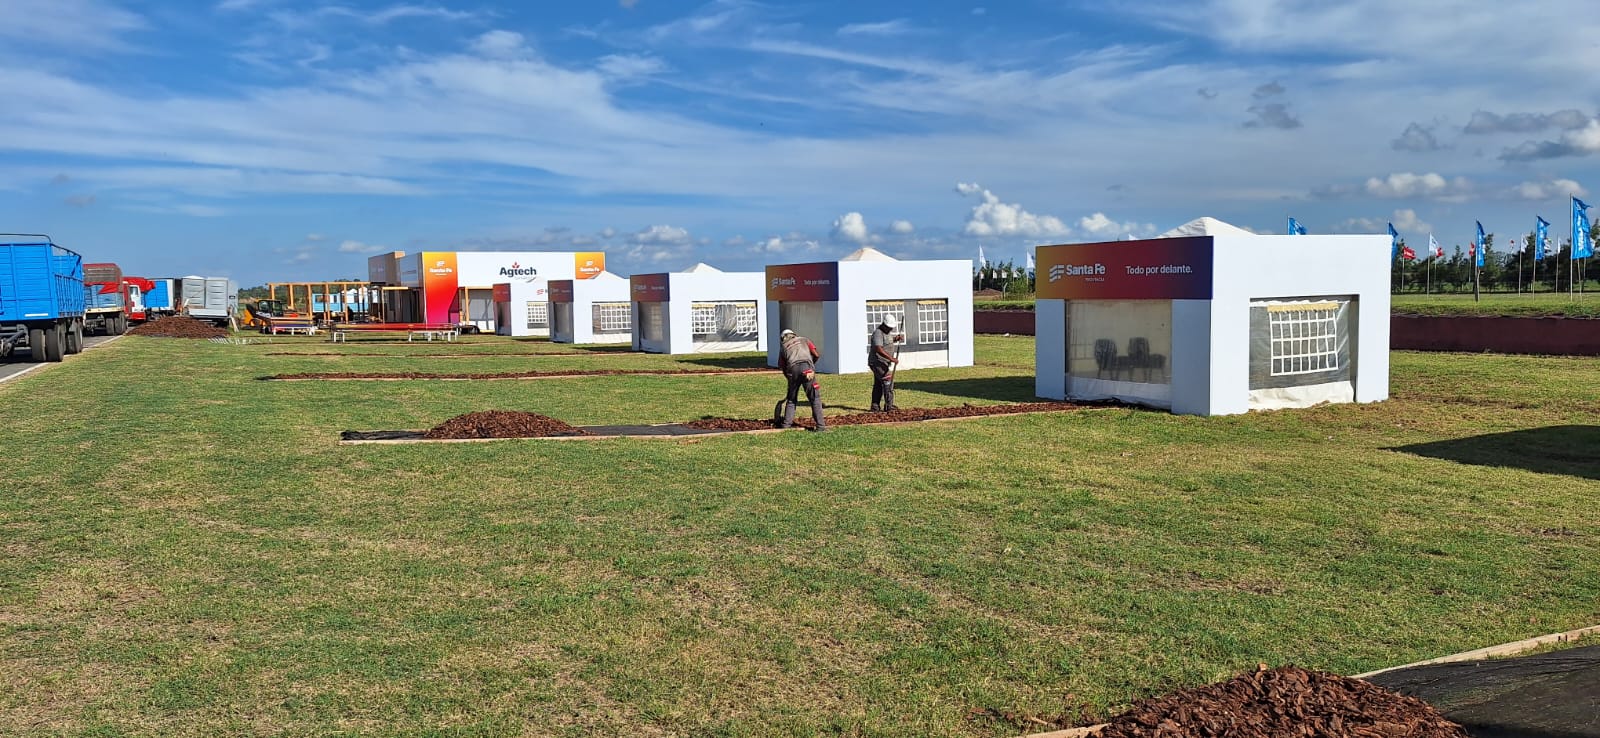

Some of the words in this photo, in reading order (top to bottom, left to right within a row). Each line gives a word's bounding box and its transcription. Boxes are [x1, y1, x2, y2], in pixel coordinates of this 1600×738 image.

[499, 266, 537, 278] Agtech
[1067, 264, 1093, 275] Santa
[1095, 263, 1106, 275] Fe
[1126, 265, 1144, 275] Todo
[1145, 266, 1158, 277] por
[1160, 264, 1193, 274] delante.
